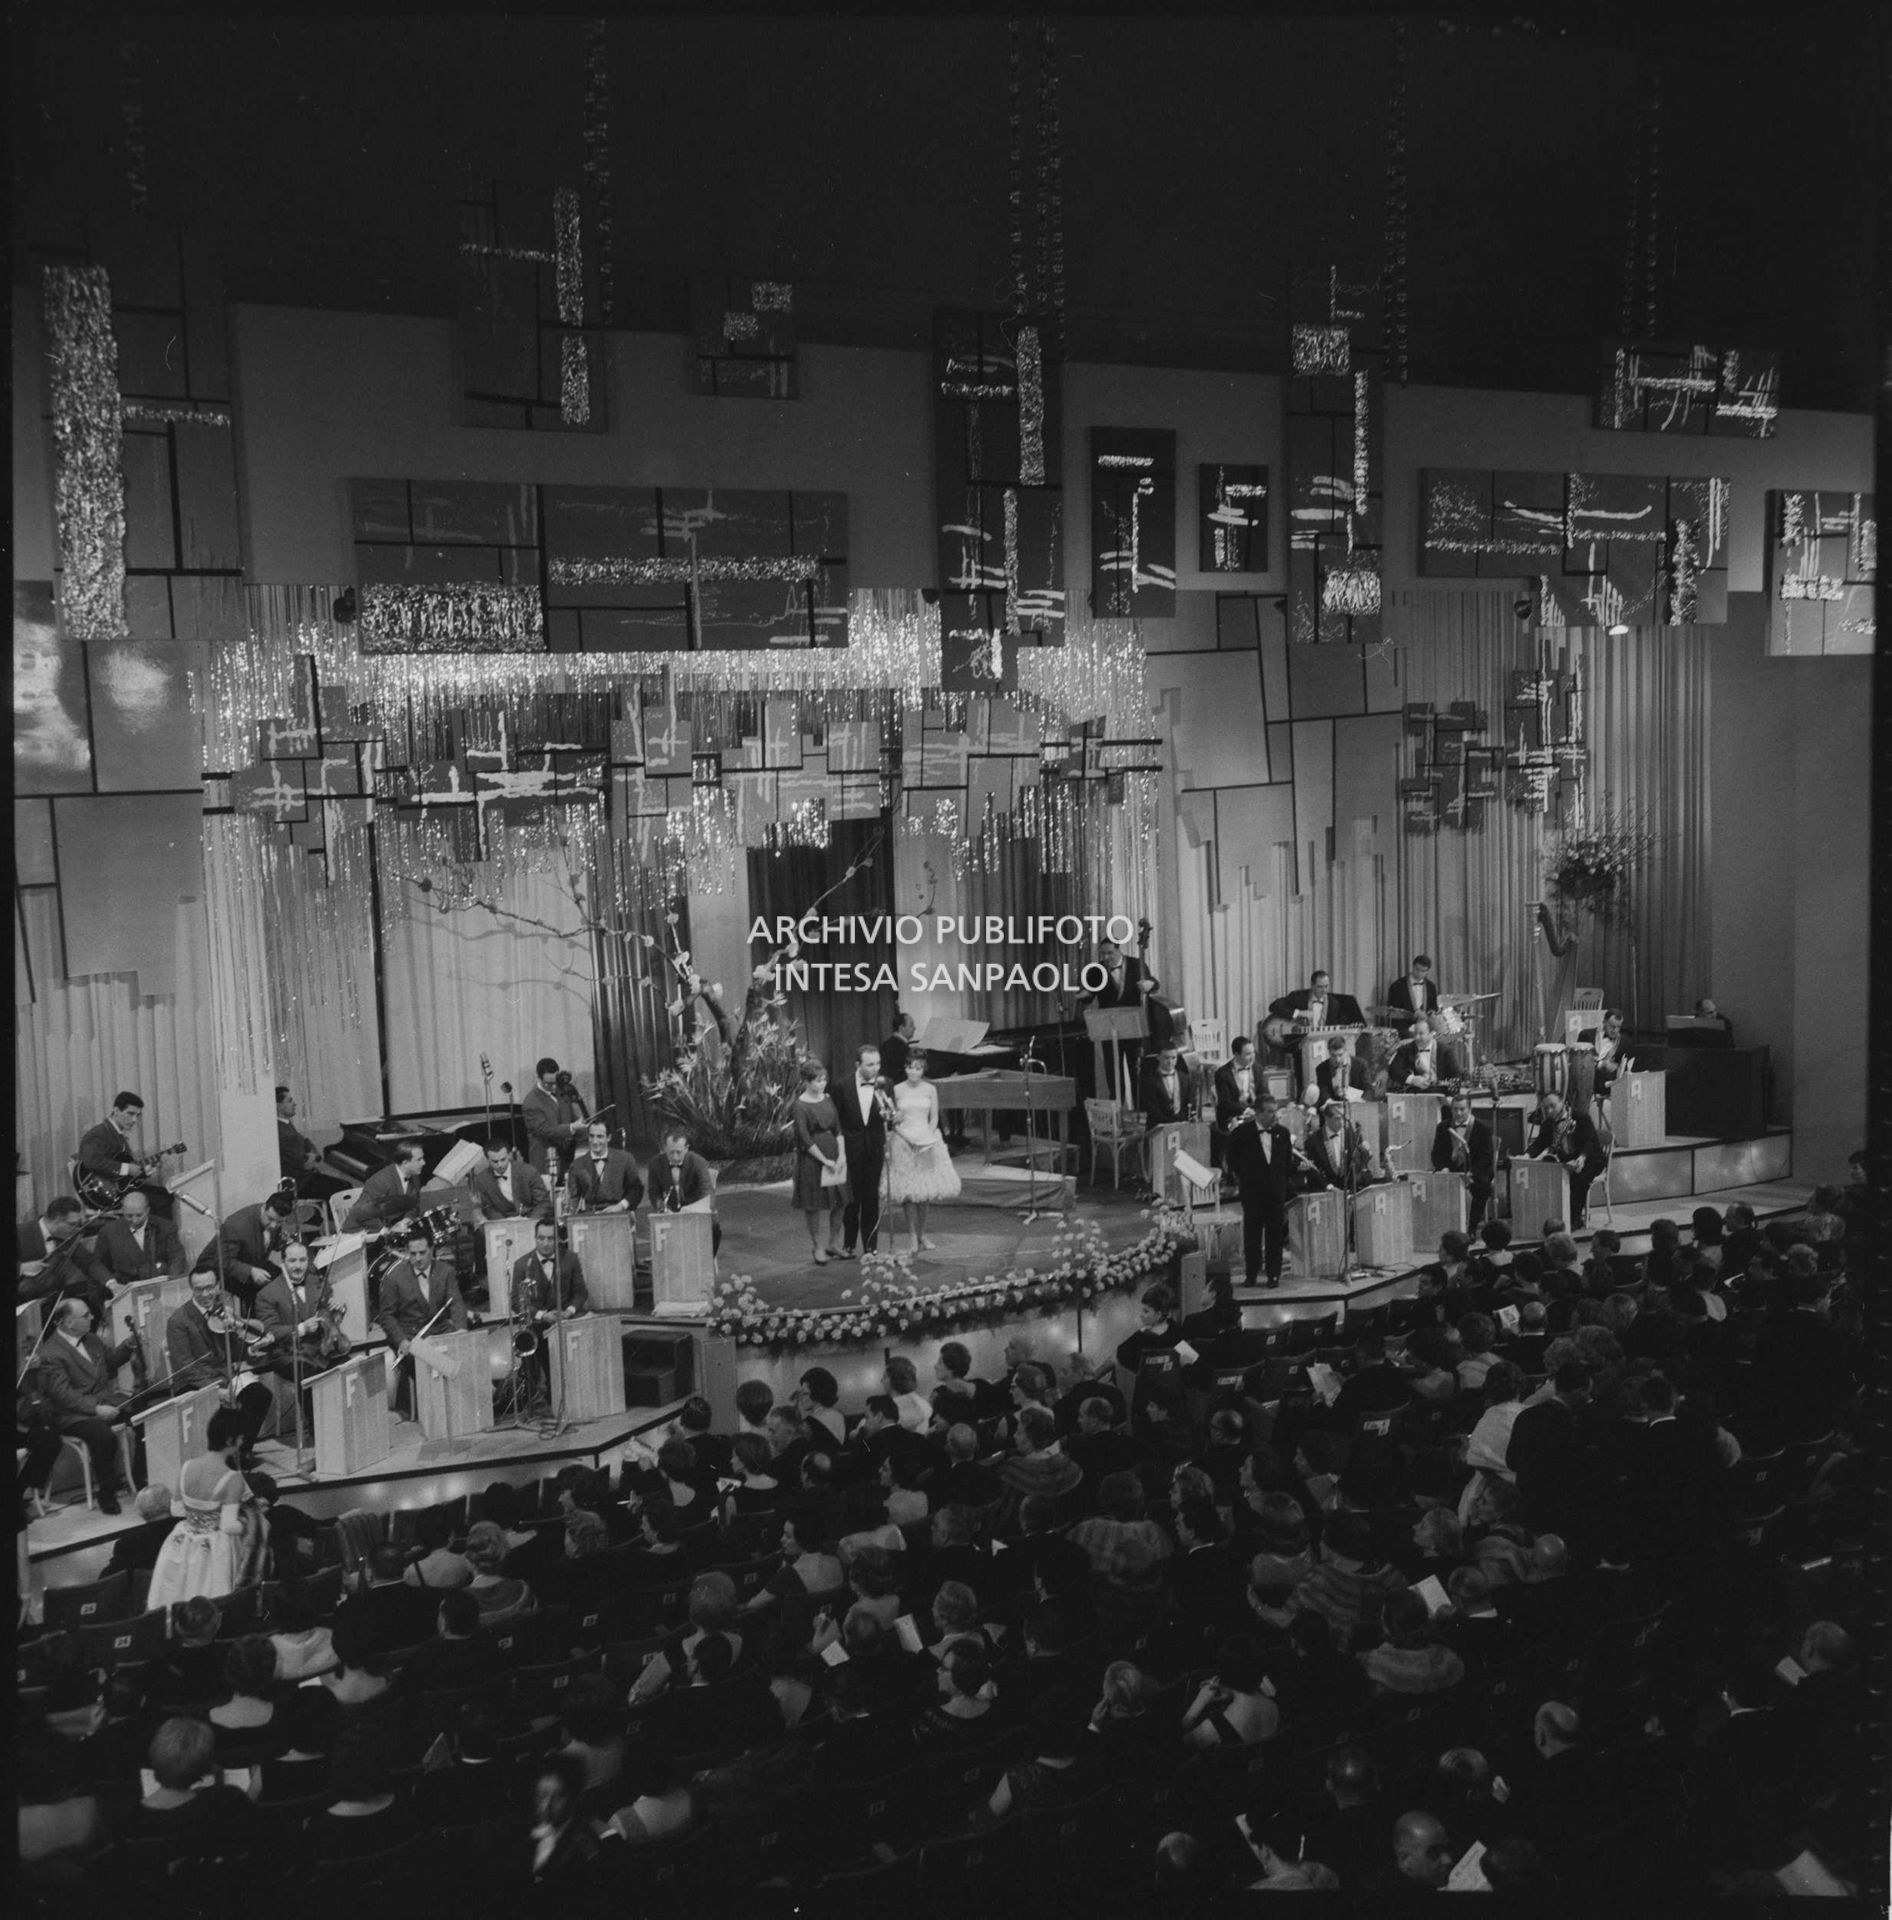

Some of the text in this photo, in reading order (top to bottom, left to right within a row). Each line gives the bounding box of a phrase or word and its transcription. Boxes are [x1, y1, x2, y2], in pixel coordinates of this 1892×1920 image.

[490, 1228, 507, 1259] F
[572, 1224, 589, 1254] F
[655, 1222, 672, 1252] F
[137, 1293, 154, 1328] F
[566, 1331, 582, 1362] F
[345, 1372, 358, 1408] F
[182, 1406, 193, 1443] F
